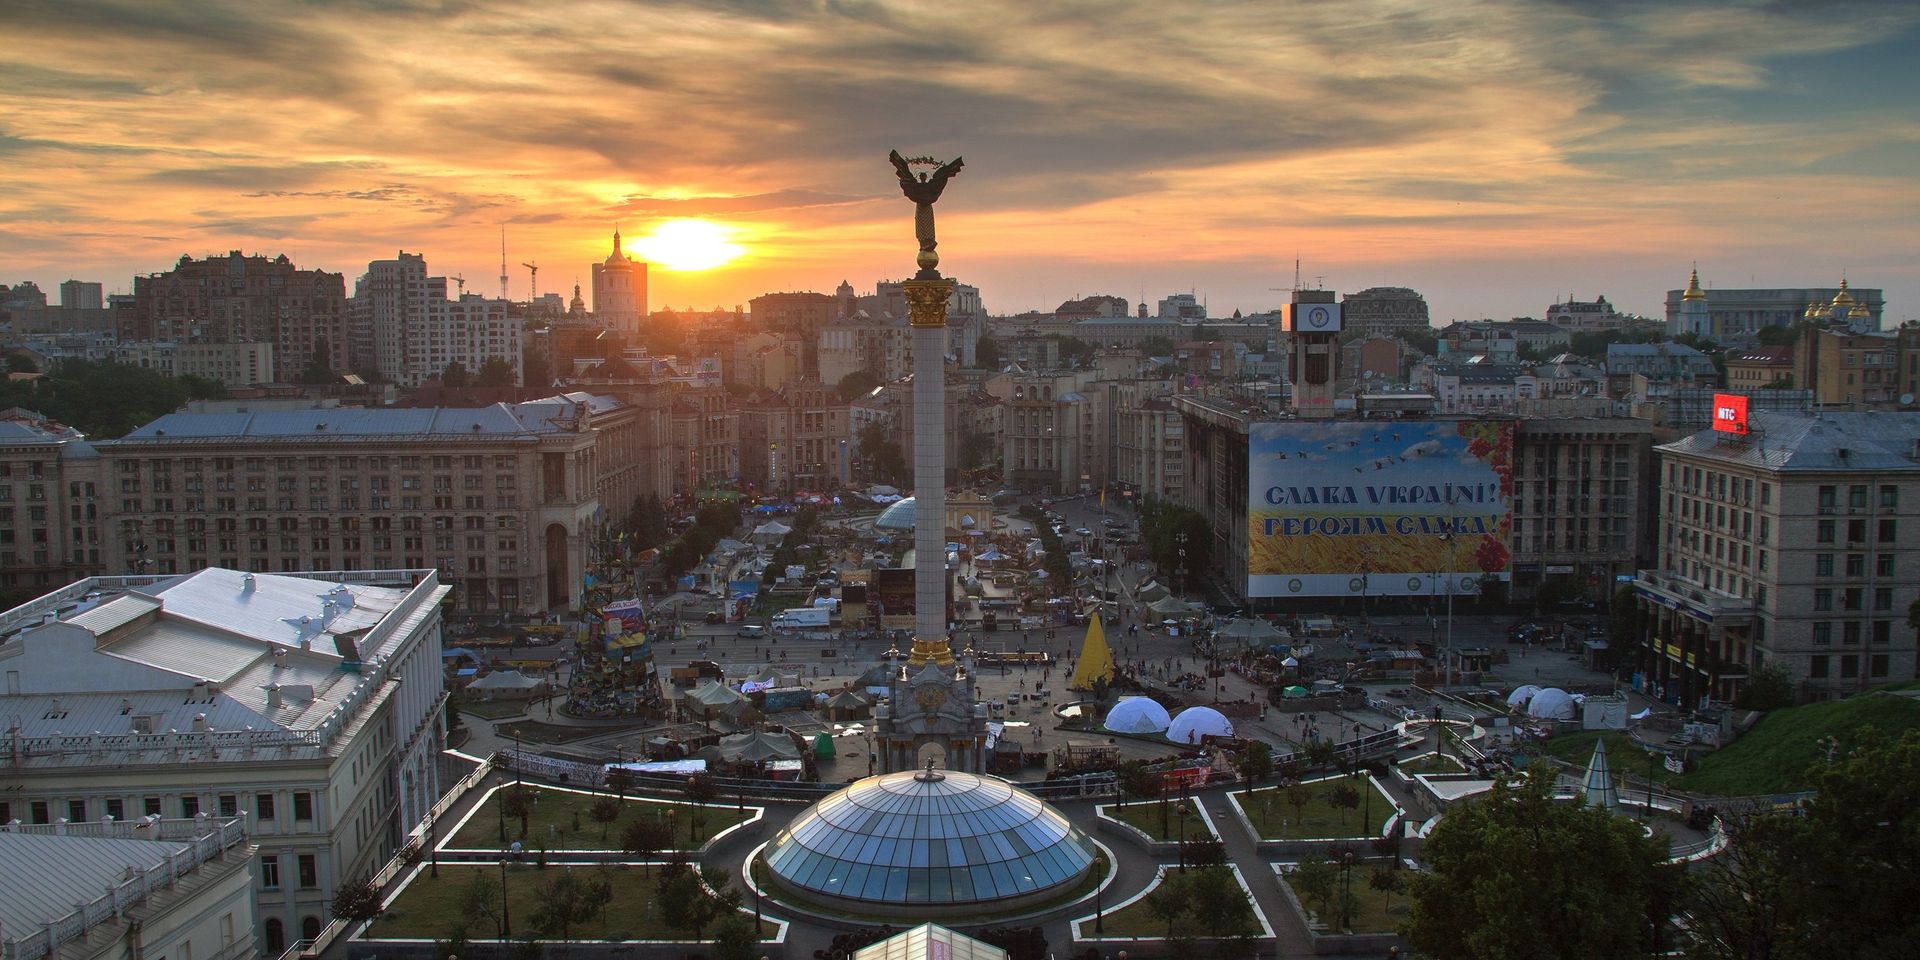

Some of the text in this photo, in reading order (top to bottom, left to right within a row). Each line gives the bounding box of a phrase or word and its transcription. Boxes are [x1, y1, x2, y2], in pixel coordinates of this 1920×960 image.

[1264, 482, 1496, 505] СЛАВА УКРАЇНІ!
[1263, 514, 1498, 536] ГЕРОЯМ СЛАВА!
